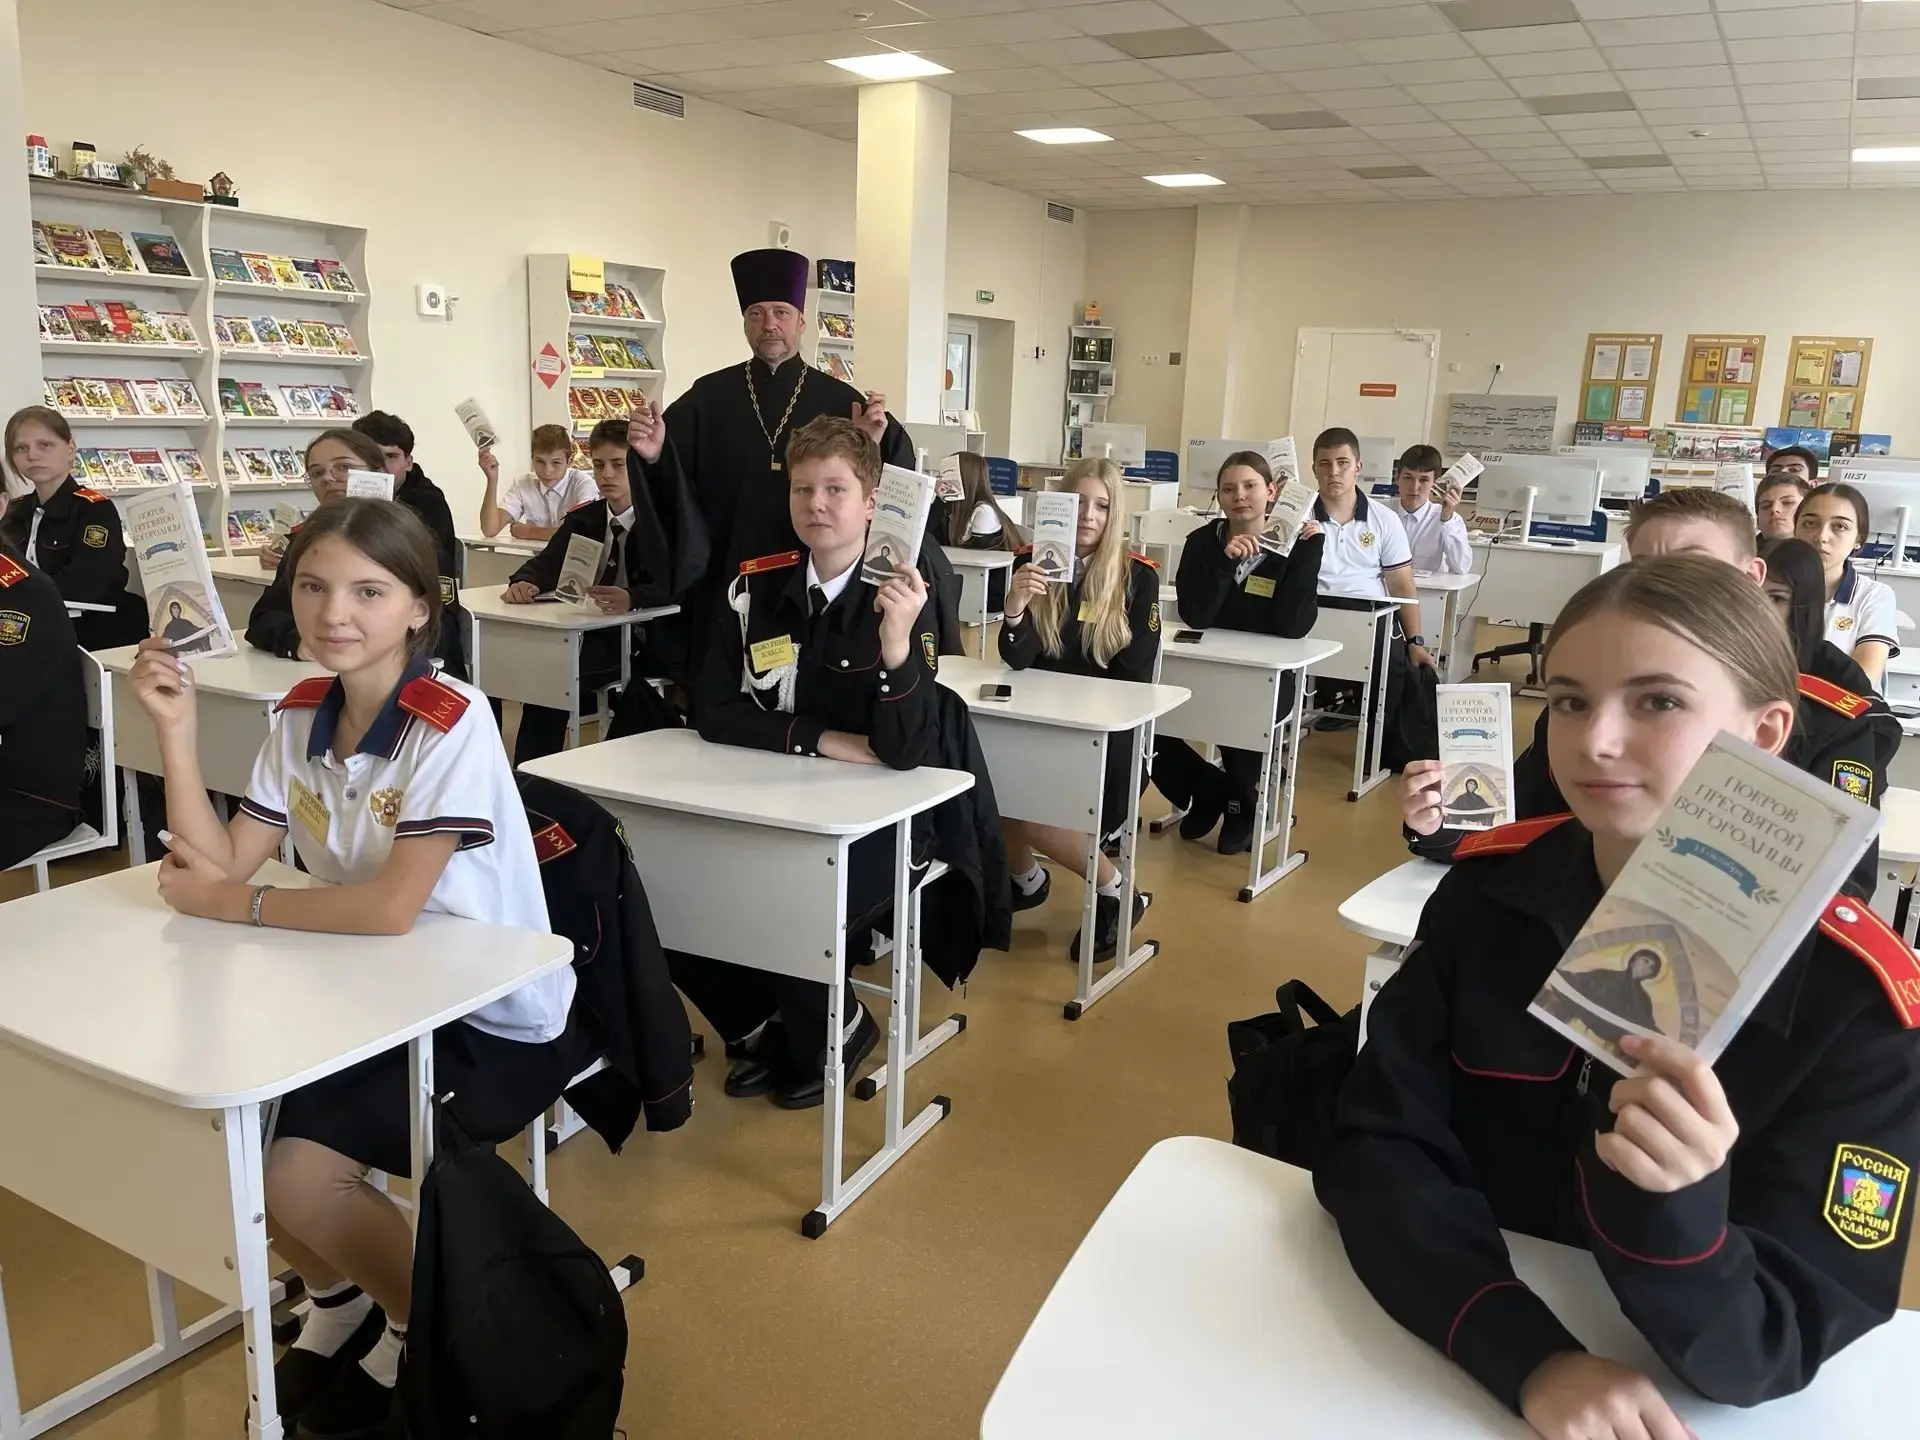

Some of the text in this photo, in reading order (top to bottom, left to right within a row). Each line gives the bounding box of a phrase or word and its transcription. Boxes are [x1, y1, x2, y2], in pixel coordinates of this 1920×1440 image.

[433, 697, 457, 720] КК
[1835, 695, 1861, 711] КК
[1837, 763, 1871, 779] РОССИЯ
[1724, 775, 1799, 823] ПОКРОВ
[1693, 783, 1805, 852] ПРЕСВЯТОЙ
[546, 831, 567, 851] КК
[1673, 795, 1804, 876] БОГОРОДИЦЫ
[1841, 1151, 1905, 1182] РОССИЯ
[1832, 1203, 1890, 1233] КАЗАЧИЙ
[1840, 1219, 1879, 1240] КЛАСС
